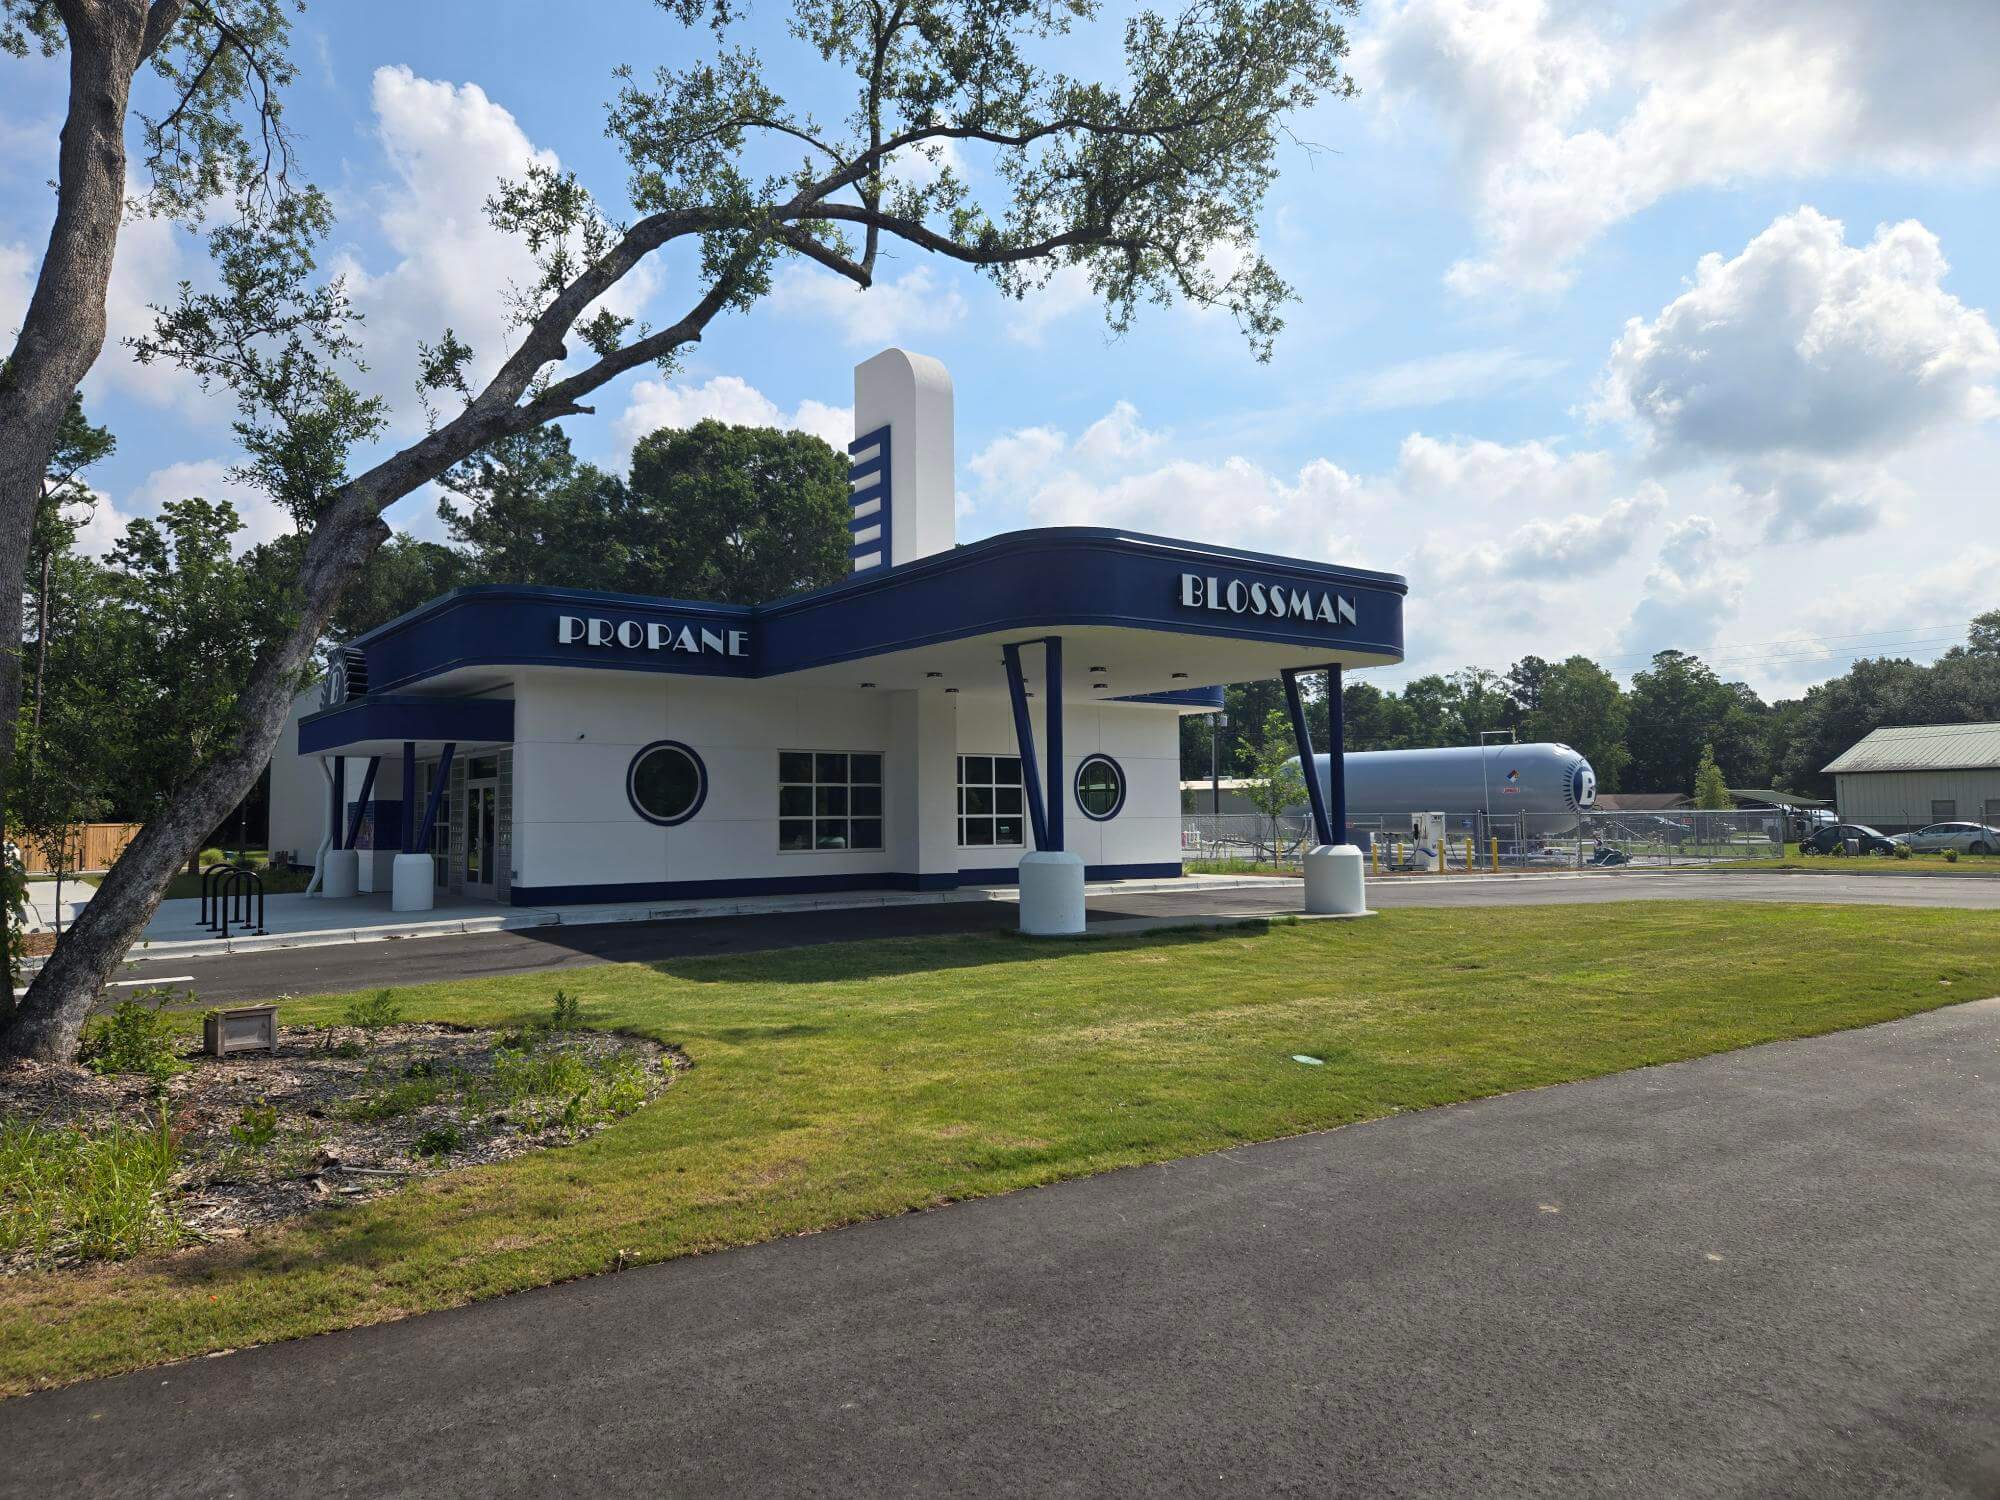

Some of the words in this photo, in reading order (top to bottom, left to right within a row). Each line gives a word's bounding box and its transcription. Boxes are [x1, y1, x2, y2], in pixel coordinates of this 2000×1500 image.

[1181, 573, 1357, 626] BLOSSMAN
[558, 615, 749, 657] PROPANE
[1580, 770, 1596, 805] B
